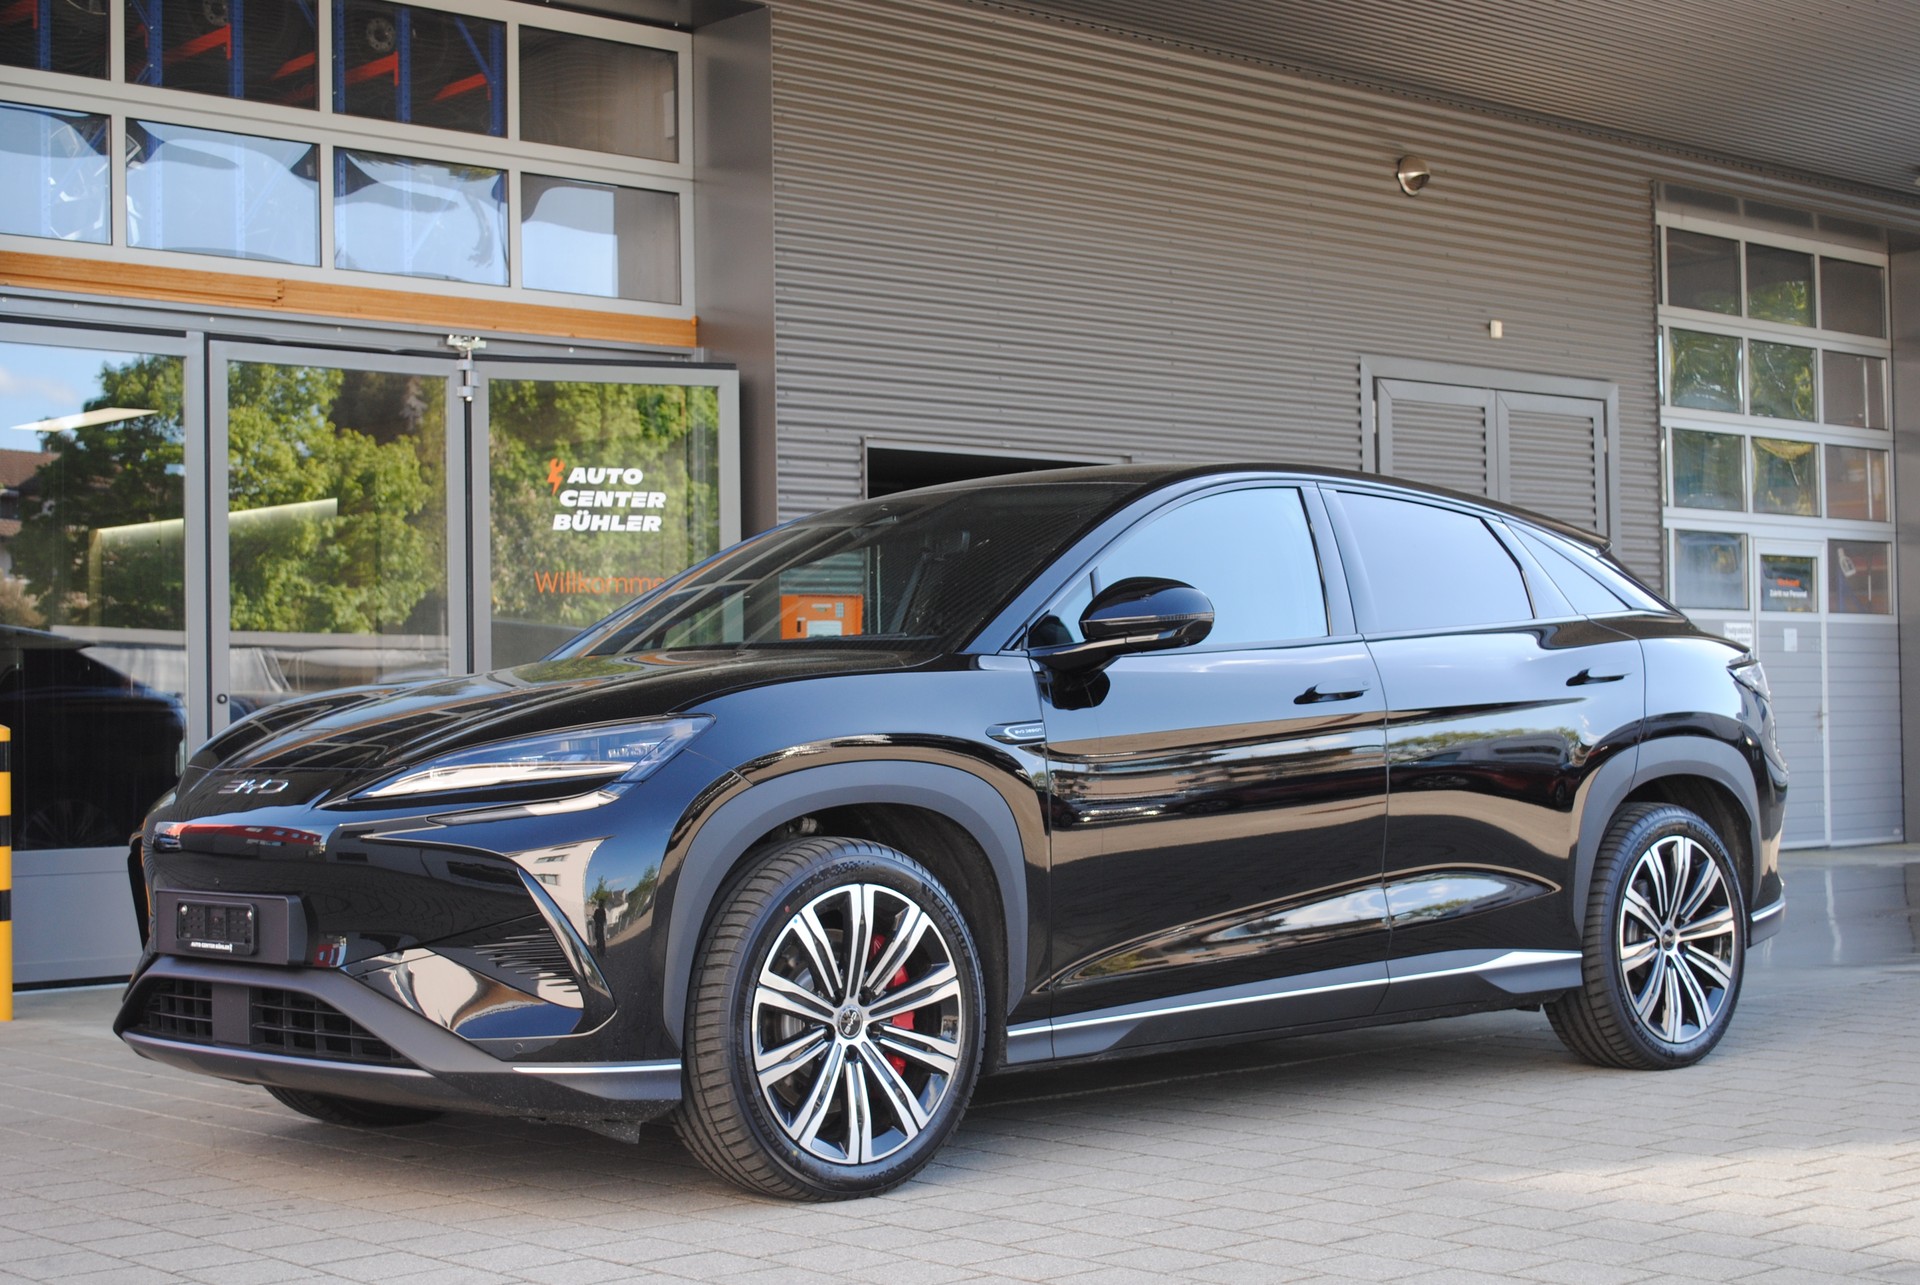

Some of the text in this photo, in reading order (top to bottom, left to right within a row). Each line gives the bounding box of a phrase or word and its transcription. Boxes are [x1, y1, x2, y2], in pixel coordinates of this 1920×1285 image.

[567, 467, 644, 485] AUTO
[559, 490, 667, 508] CENTER
[552, 510, 662, 532] BÜHLER
